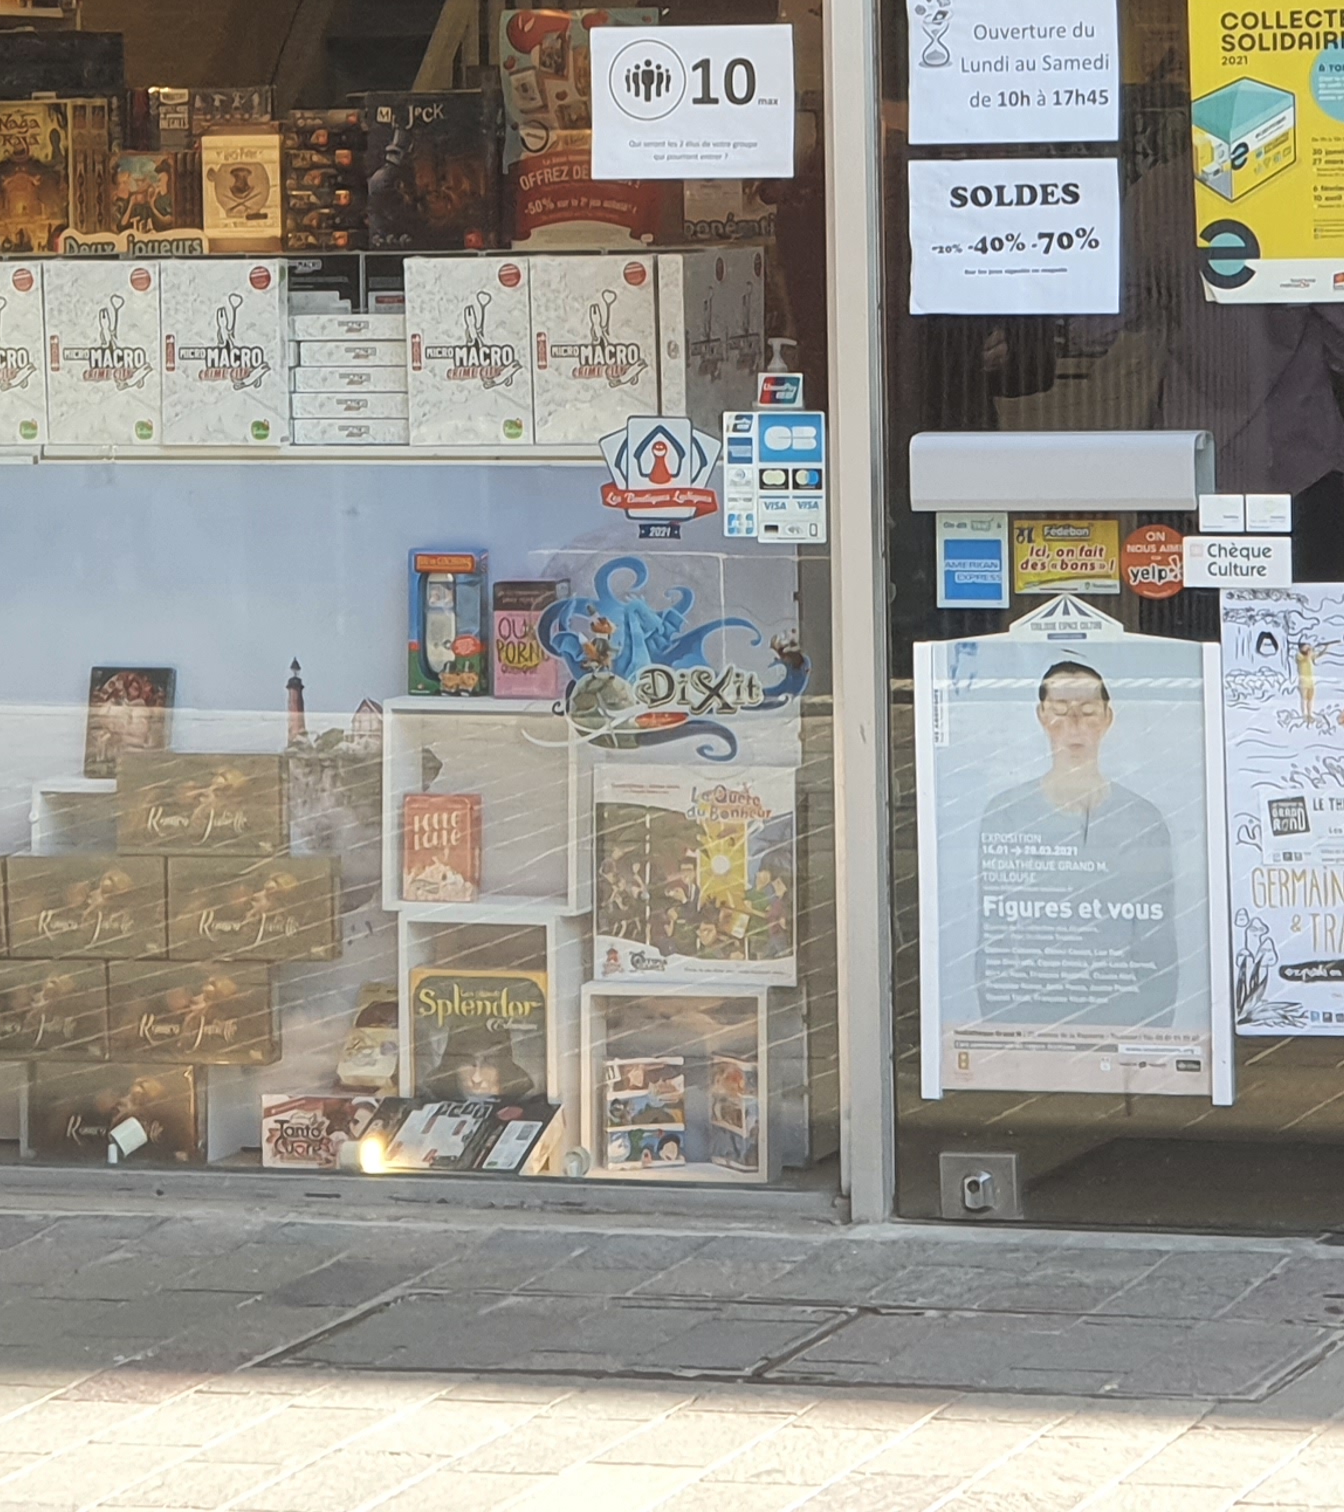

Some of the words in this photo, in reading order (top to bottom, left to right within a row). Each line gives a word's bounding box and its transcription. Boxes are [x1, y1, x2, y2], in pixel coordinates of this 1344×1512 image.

[973, 24, 1067, 40] Ouverture
[1073, 21, 1095, 38] du
[961, 56, 1009, 73] Lundi
[1015, 58, 1036, 71] au
[1042, 54, 1110, 71] Samedi
[1221, 55, 1249, 66] 2021
[691, 58, 756, 105] 10
[970, 91, 991, 108] de
[998, 90, 1030, 107] 10h
[1037, 90, 1046, 106] à
[1053, 89, 1109, 106] 17h45
[520, 165, 569, 191] OFFREZ
[573, 165, 591, 180] DE
[950, 183, 1080, 208] SOLDES
[524, 198, 555, 215] -50%
[968, 233, 1025, 254] -40%
[1031, 227, 1100, 254] -70%
[90, 348, 146, 368] MACRO
[206, 347, 264, 368] MACRO
[455, 345, 514, 366] MACRO
[580, 344, 640, 364] MACRO
[764, 501, 786, 510] VISA
[797, 501, 819, 509] VISA
[649, 527, 671, 537] 2021
[1146, 532, 1165, 541] ON
[1030, 546, 1050, 558] Ici,
[1056, 547, 1074, 558] on
[1079, 545, 1104, 558] fait
[1127, 544, 1156, 553] NOUS
[1207, 543, 1272, 560] Chèque
[944, 560, 999, 569] AMERICAN
[1020, 559, 1046, 571] des
[1130, 563, 1167, 583] yelp
[1208, 562, 1267, 576] Culture
[1313, 798, 1324, 811] LE
[981, 833, 1041, 843] EXPOSITION
[983, 895, 1073, 921] Figures
[1079, 898, 1103, 919] et
[1108, 901, 1163, 920] vous
[1290, 914, 1301, 933] &
[419, 983, 542, 1026] Splendor
[274, 1120, 322, 1138] Tanto
